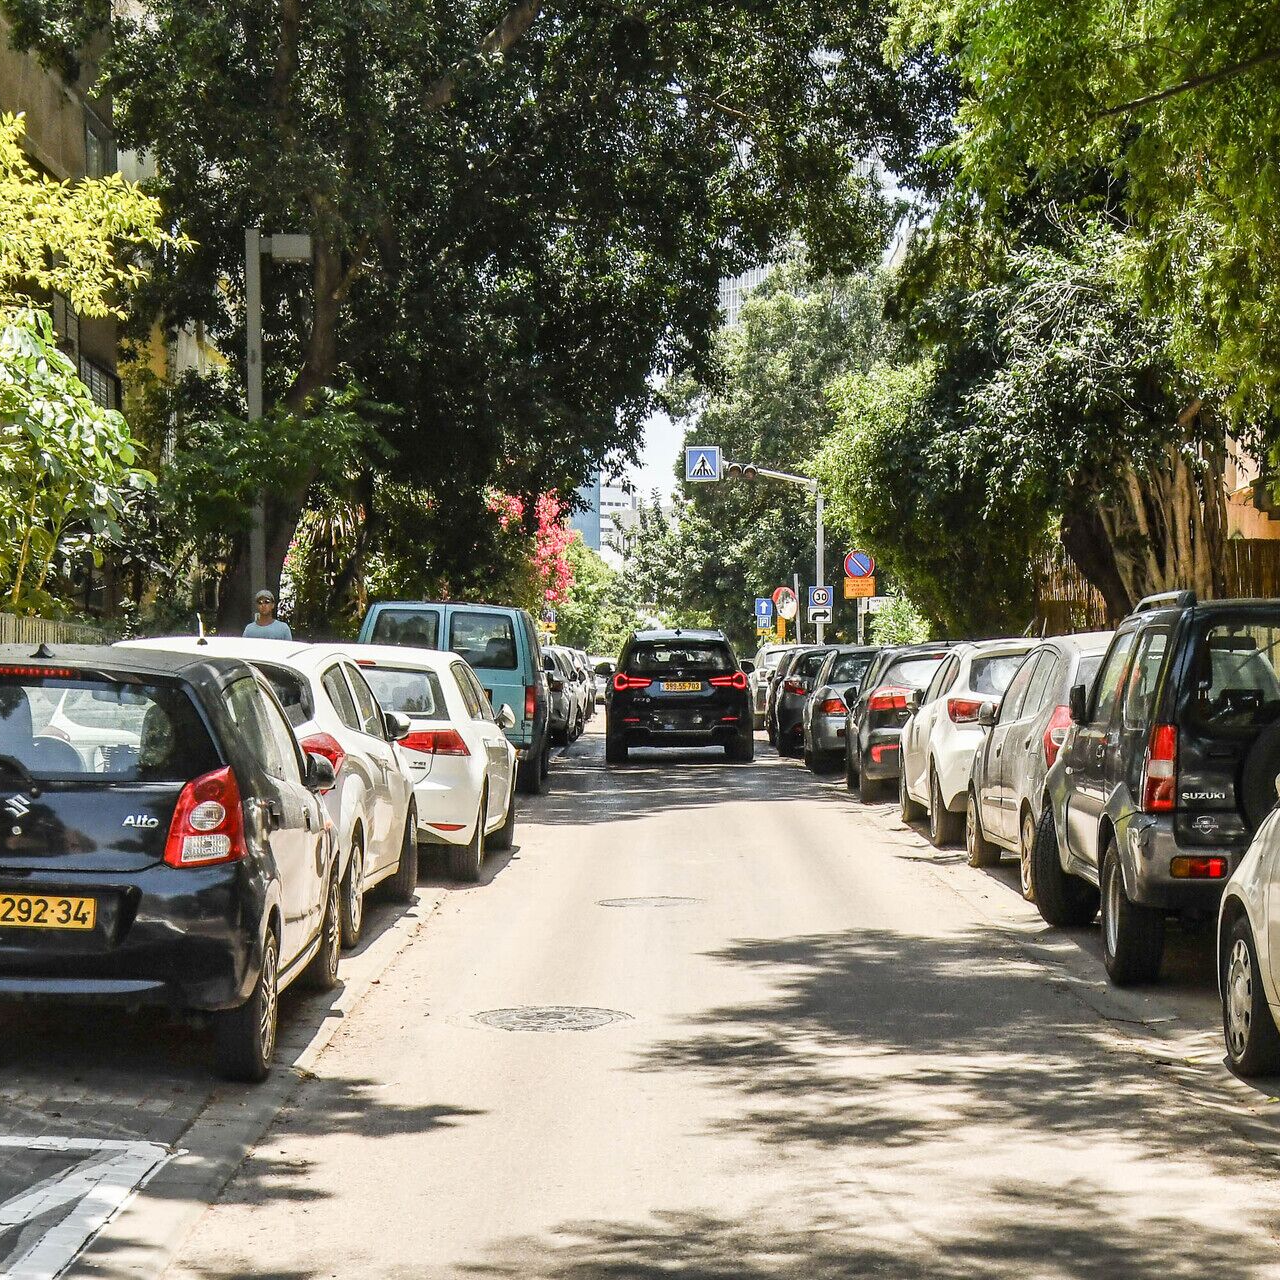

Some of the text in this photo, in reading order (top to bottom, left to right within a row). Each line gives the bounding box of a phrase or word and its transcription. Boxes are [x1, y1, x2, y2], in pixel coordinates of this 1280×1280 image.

[815, 592, 826, 601] 30
[1181, 792, 1226, 800] SUZUKI
[122, 814, 159, 828] Alto
